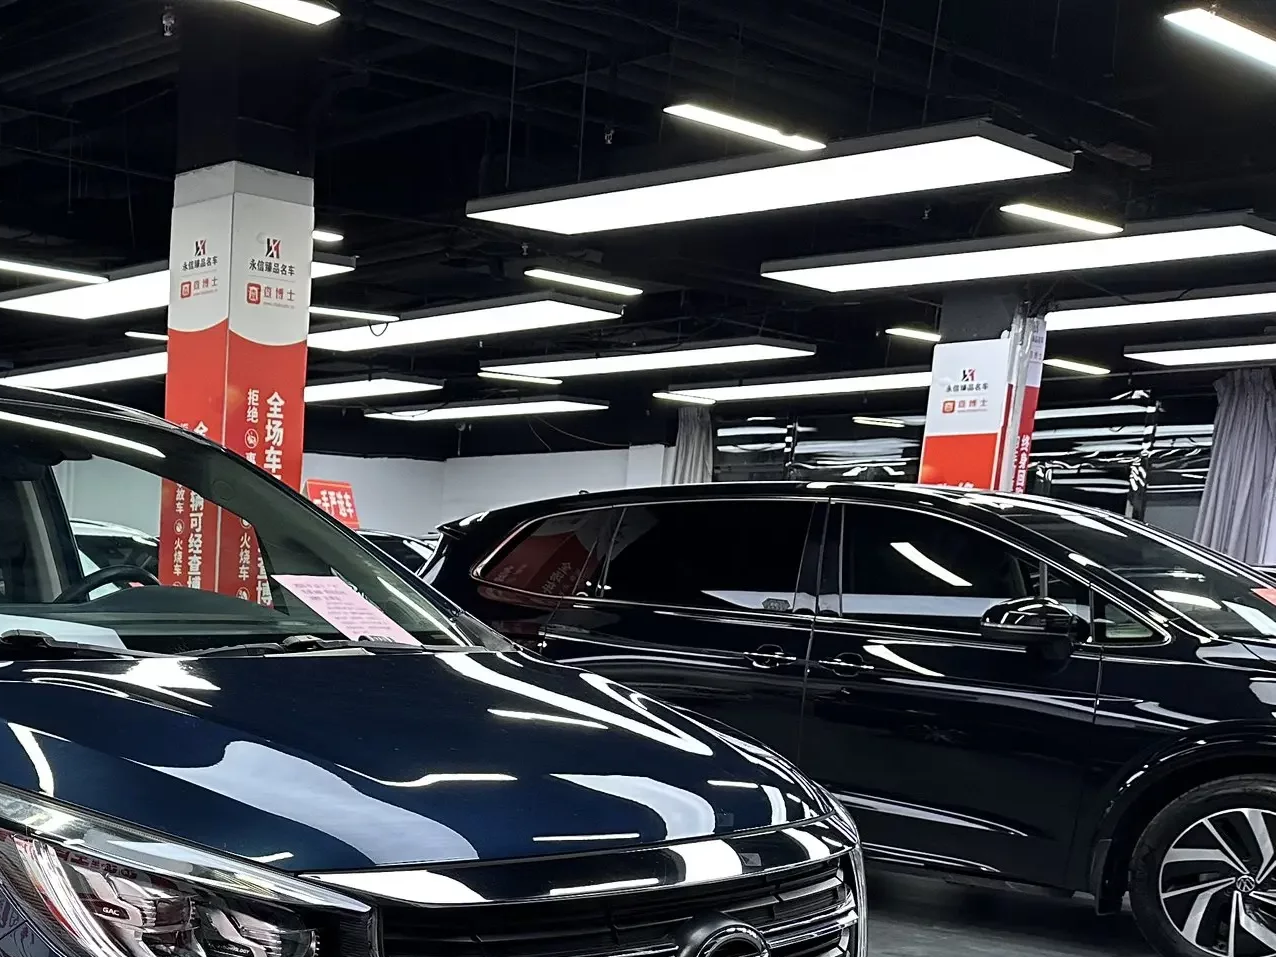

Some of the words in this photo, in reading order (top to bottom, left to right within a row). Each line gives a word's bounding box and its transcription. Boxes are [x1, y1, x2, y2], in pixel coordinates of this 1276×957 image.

[182, 256, 219, 271] 永信臻品名车
[249, 259, 296, 276] 永信臻品名车
[246, 388, 259, 423] 拒绝
[264, 391, 285, 480] 全场车
[175, 482, 186, 514] 故车
[173, 538, 183, 576] 火烧车
[238, 533, 251, 581] 火烧车
[103, 906, 120, 917] GAC
